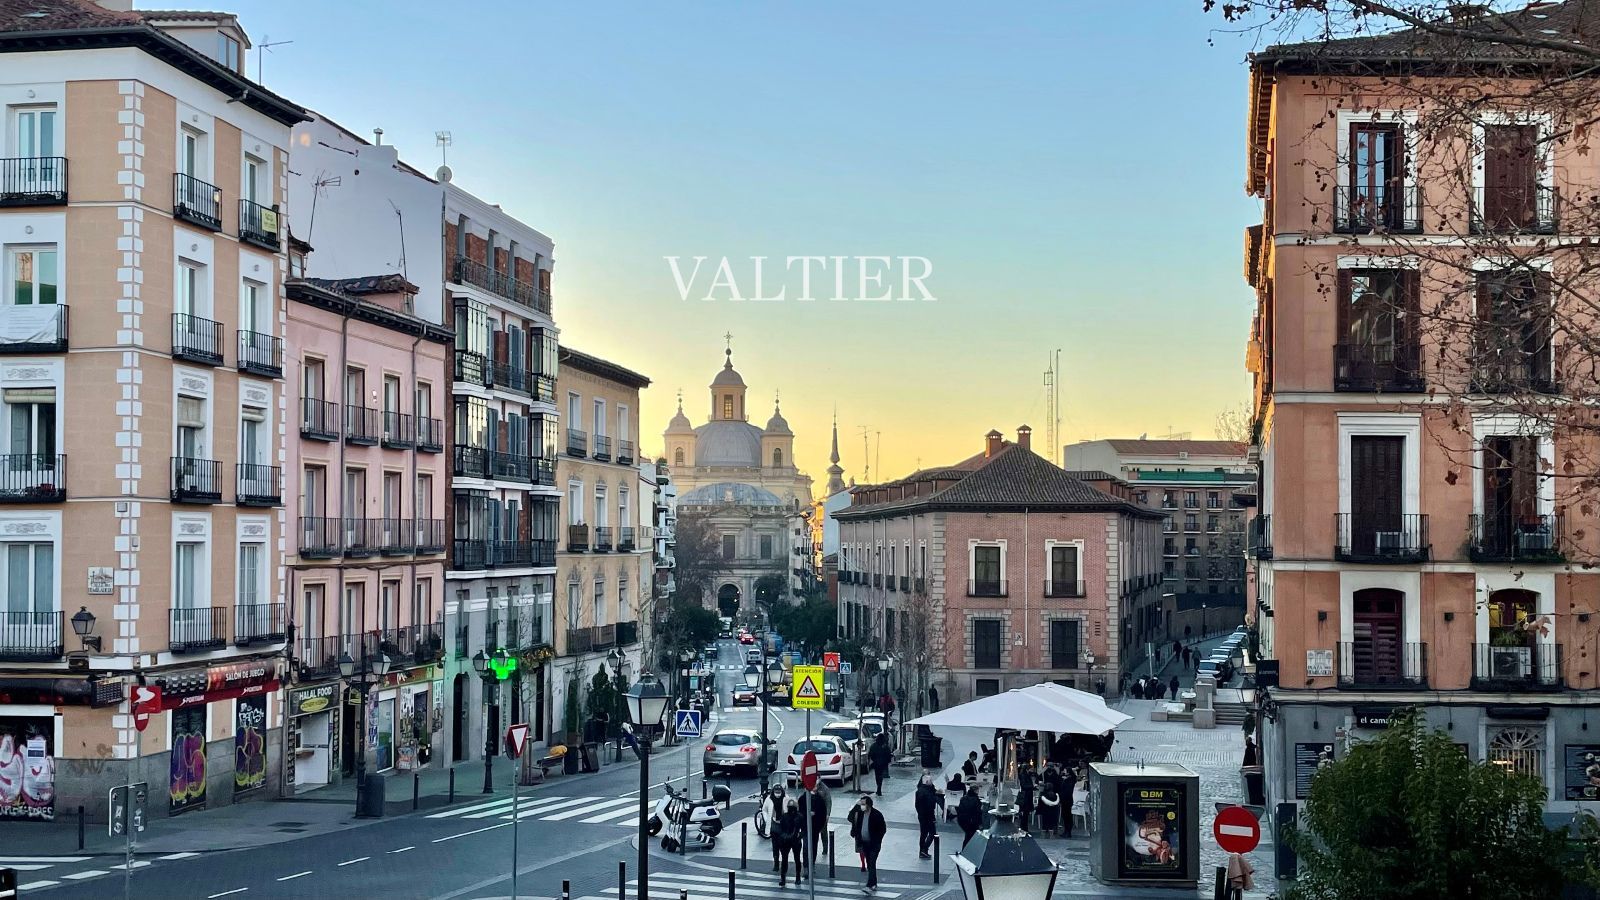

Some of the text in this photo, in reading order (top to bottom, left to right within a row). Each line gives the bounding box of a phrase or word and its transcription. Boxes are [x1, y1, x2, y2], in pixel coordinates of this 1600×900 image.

[249, 668, 265, 678] JUEGO
[300, 686, 333, 700] HALAL FOOD
[1360, 716, 1367, 724] el
